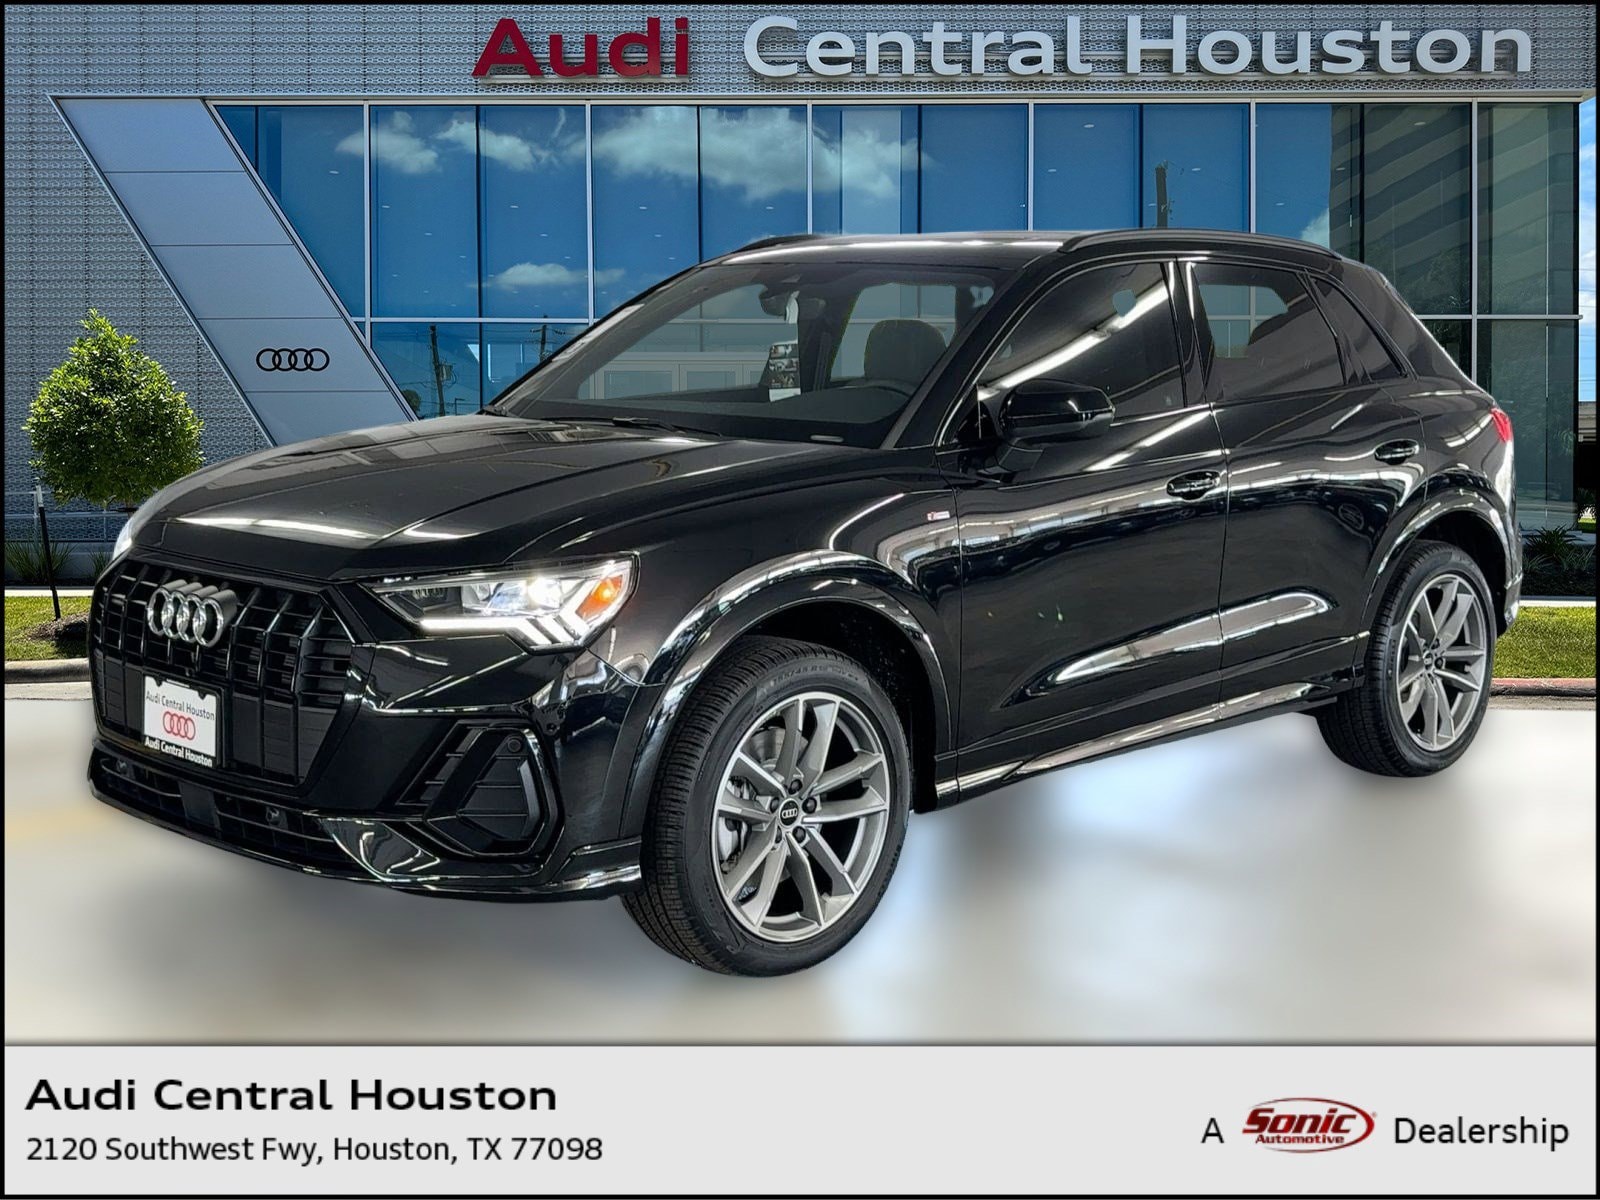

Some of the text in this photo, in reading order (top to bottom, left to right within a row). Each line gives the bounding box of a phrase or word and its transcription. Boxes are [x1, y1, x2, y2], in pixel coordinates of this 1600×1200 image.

[474, 15, 1532, 77] Audi Central Houston
[145, 690, 215, 721] Audi Central Houston
[144, 736, 213, 768] Audi Central Houston
